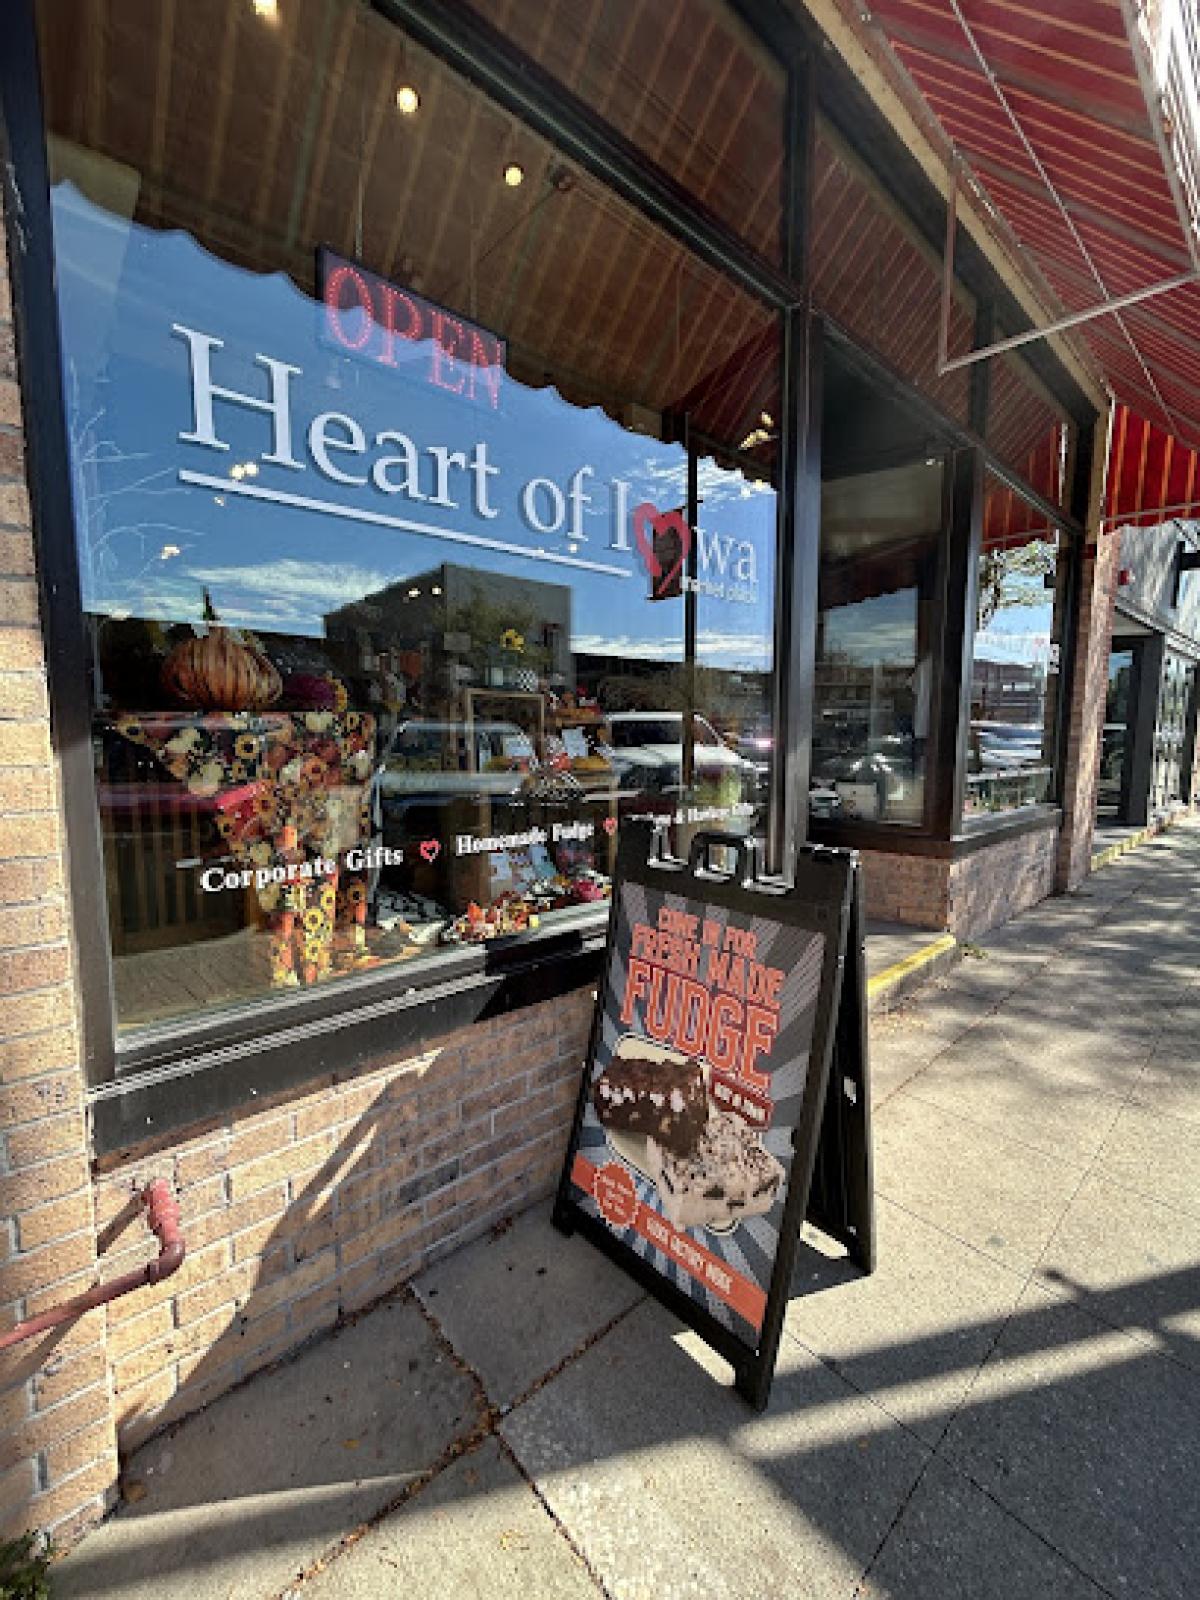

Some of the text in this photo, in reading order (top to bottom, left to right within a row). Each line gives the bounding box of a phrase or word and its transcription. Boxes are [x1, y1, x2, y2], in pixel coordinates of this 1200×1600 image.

[325, 264, 503, 410] OPEN
[171, 322, 501, 520] Heart
[522, 465, 593, 543] of
[200, 844, 403, 892] Corporate Gifts
[455, 825, 548, 857] Homemade
[552, 820, 595, 842] Fudge
[630, 922, 785, 1010] FRESH MADE
[658, 905, 757, 959] COME IN FOR
[619, 956, 780, 1092] FUDGE
